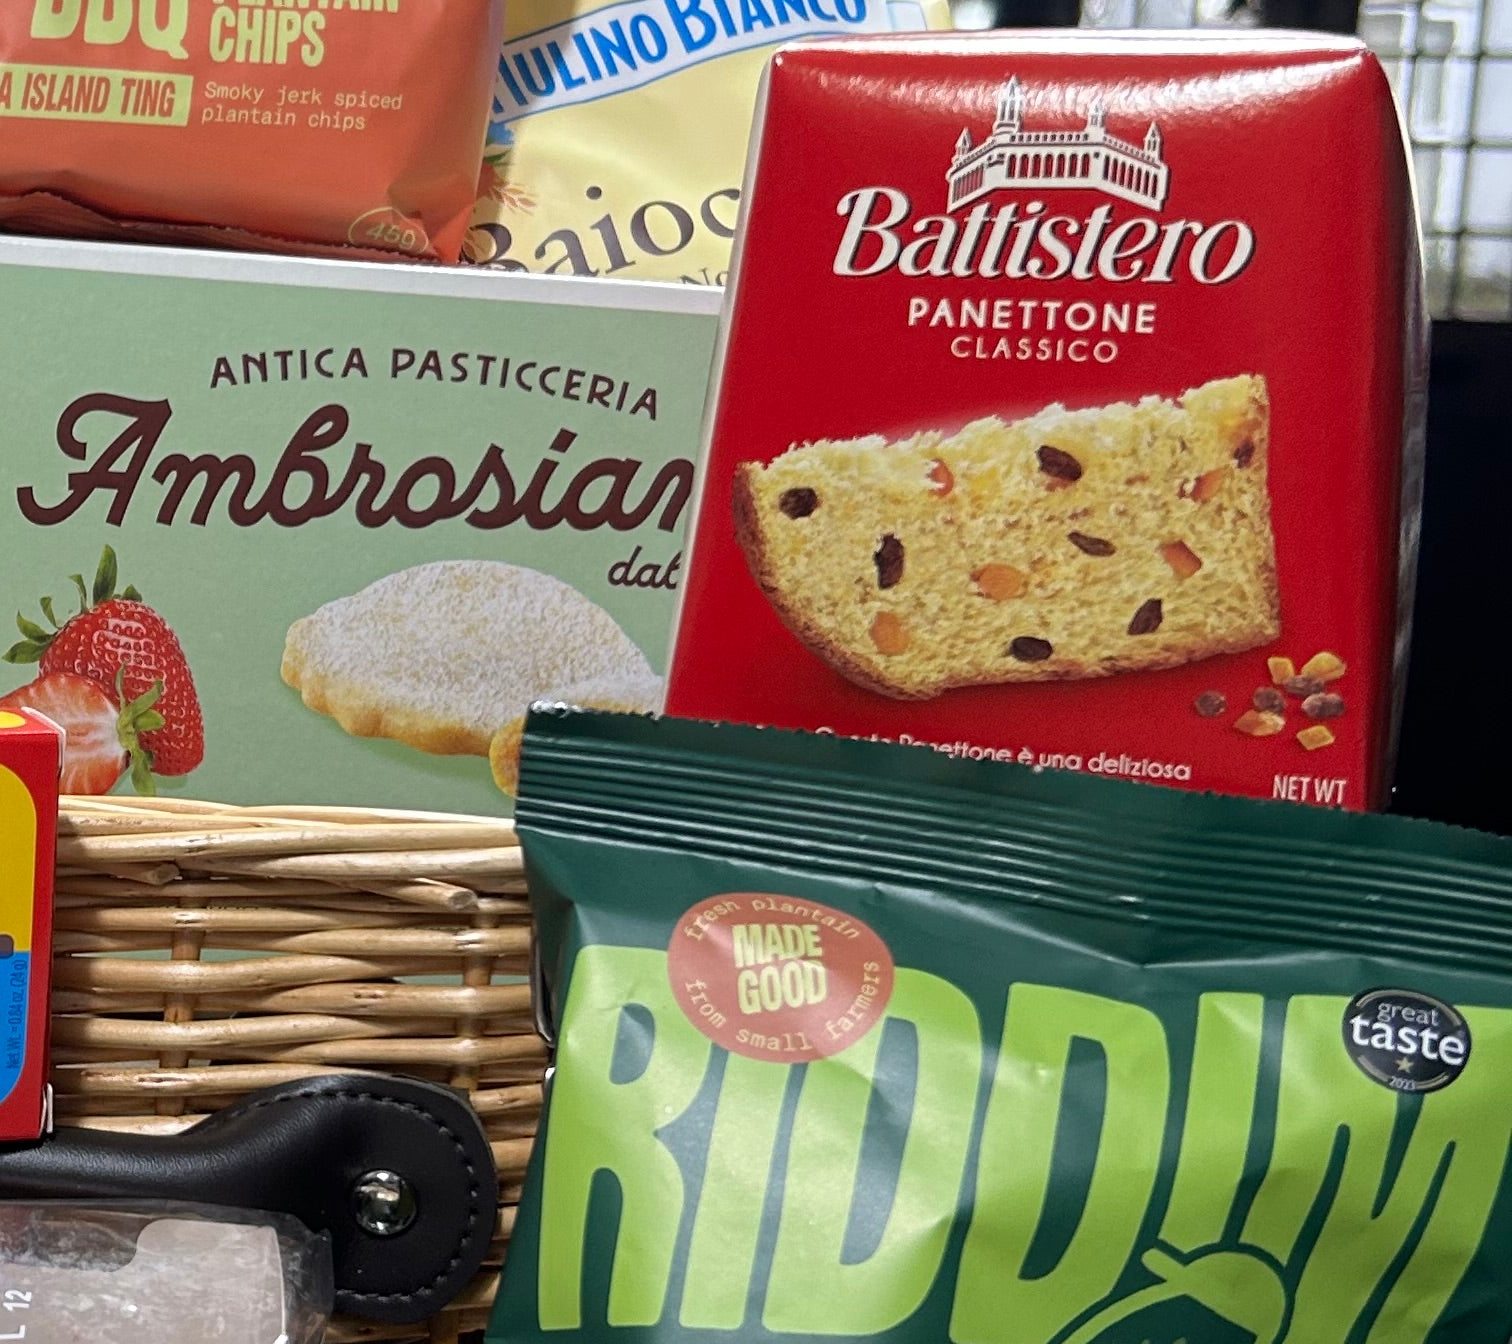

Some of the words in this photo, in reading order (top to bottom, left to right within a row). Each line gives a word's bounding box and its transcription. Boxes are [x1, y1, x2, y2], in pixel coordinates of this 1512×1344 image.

[209, 5, 326, 67] CHIPS
[20, 71, 111, 115] ISLAND
[119, 76, 176, 119] TING
[201, 104, 296, 126] plantain
[308, 111, 367, 132] chips
[204, 81, 264, 104] Smoky
[277, 86, 322, 105] jerk
[334, 91, 403, 110] spiced
[832, 186, 1256, 286] Battistero
[907, 297, 1156, 335] PANETTONE
[950, 335, 1119, 364] CLASSICO
[210, 346, 368, 389] ANTICA
[391, 348, 660, 422] PASTICCERIA
[899, 733, 1014, 765] Pettone
[1039, 755, 1084, 774] una
[1088, 752, 1192, 782] deliziosa
[1273, 773, 1312, 802] NET
[1314, 777, 1347, 804] WT
[684, 898, 740, 941] fresh
[751, 897, 860, 940] plantain
[732, 922, 823, 968] MADE
[685, 979, 727, 1029] from
[735, 1028, 813, 1052] small
[824, 960, 880, 1041] farmers
[737, 959, 828, 1015] GOOD
[1377, 1002, 1439, 1027] great
[1350, 1014, 1465, 1066] taste
[3, 1289, 32, 1312] 12
